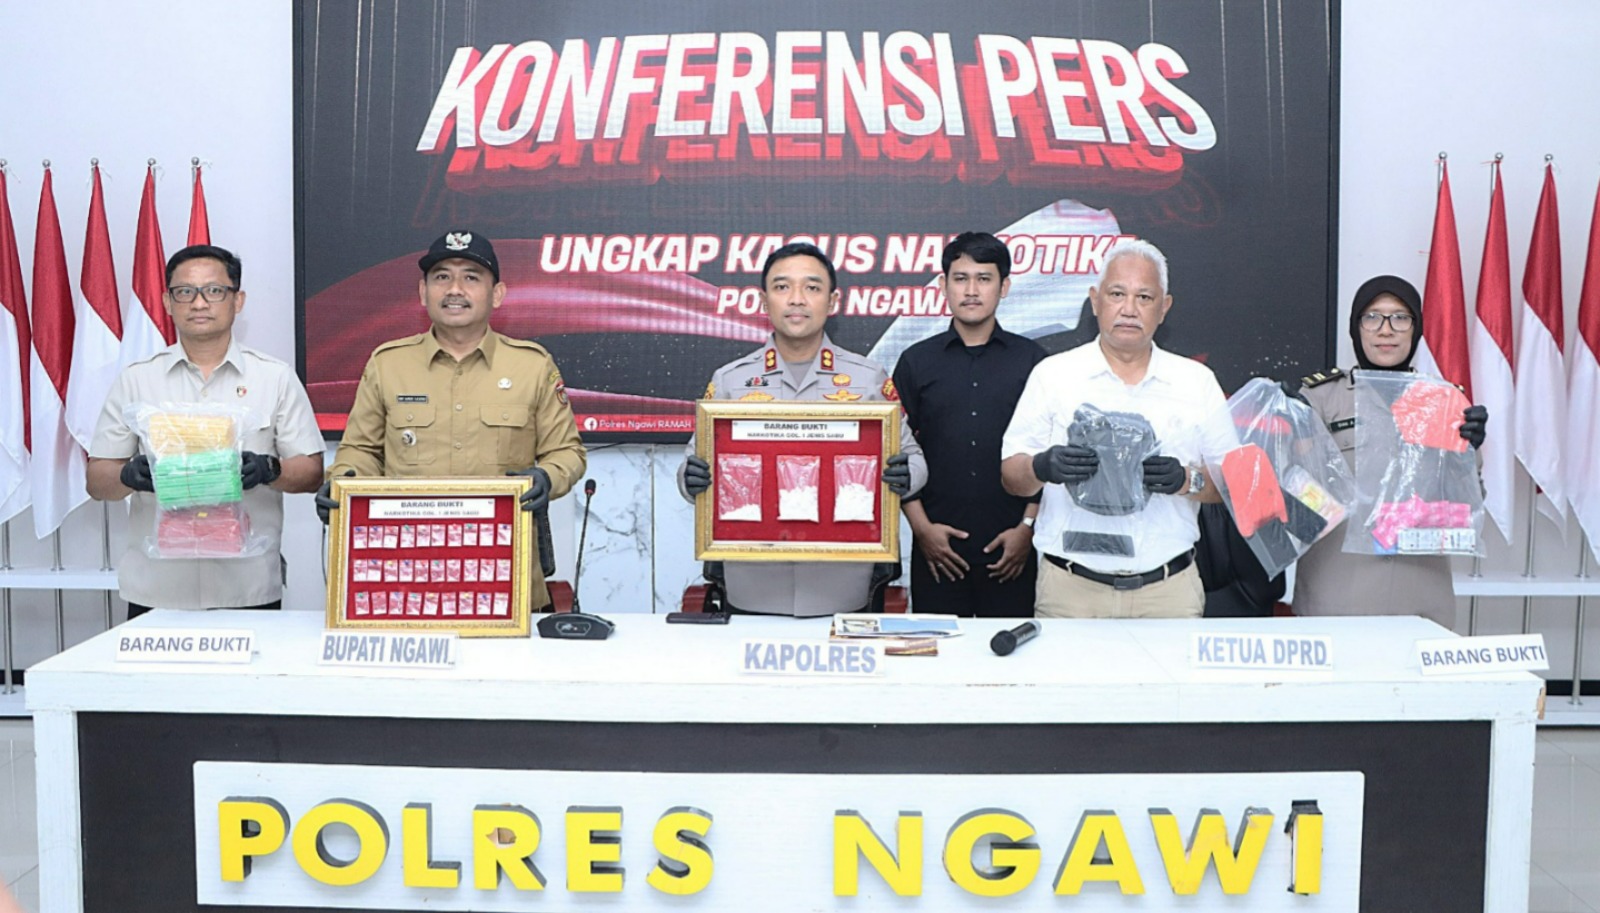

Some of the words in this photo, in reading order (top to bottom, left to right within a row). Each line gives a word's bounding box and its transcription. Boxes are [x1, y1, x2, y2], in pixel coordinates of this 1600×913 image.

[416, 30, 965, 152] KONFERENSI
[977, 33, 1217, 151] PERS
[540, 235, 720, 274] UNGKAP
[725, 234, 878, 274] KAUS
[882, 234, 1136, 274] NAOTIK
[599, 419, 626, 428] Polres
[627, 419, 656, 430] Ngawi
[658, 420, 692, 428] RAMAH
[764, 422, 799, 431] BARANG
[801, 423, 828, 431] BUKTI
[119, 636, 194, 652] BARANG
[198, 636, 250, 652] BUKTI
[322, 634, 387, 661] BUPATI
[389, 637, 450, 665] NGAWI
[744, 642, 877, 674] KAPOLRES
[1198, 636, 1267, 664] KETUA
[1272, 639, 1328, 667] DPRD
[1420, 647, 1493, 667] BARANG
[1496, 644, 1546, 662] BUKTI
[217, 795, 715, 896] POLRES
[832, 799, 1324, 897] NGAWI
